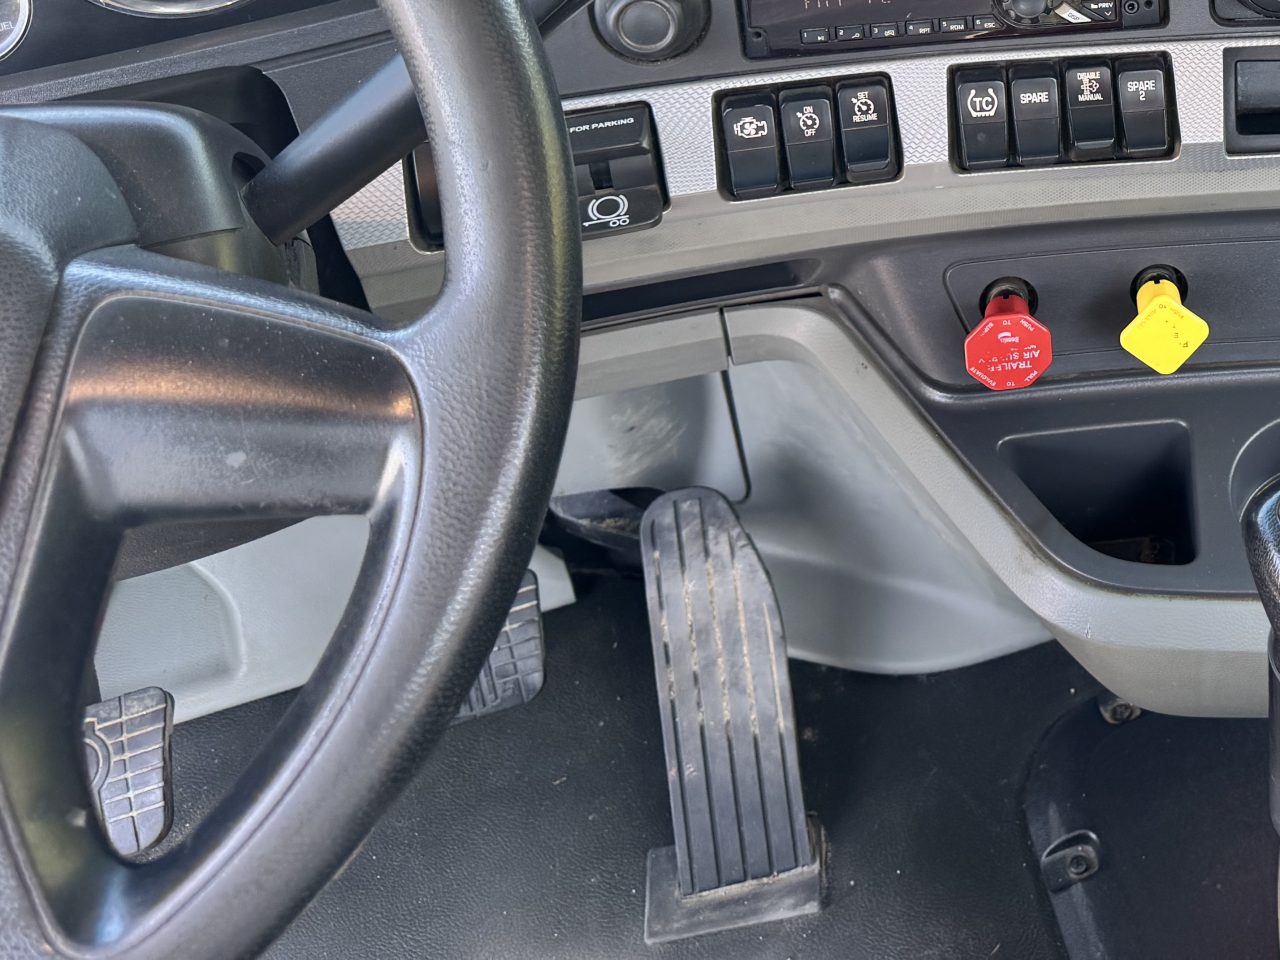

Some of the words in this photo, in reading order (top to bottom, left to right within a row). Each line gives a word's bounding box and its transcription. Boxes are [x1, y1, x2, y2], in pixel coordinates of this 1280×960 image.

[1077, 71, 1101, 80] DISABLE
[1127, 79, 1156, 92] SPARE
[857, 91, 869, 99] SET
[1020, 91, 1049, 105] SPARE
[1078, 93, 1104, 102] MANUAL
[1139, 90, 1146, 101] 2
[973, 96, 993, 112] TC
[803, 105, 813, 114] ON
[852, 112, 878, 123] RESUME
[570, 125, 589, 133] FOR
[592, 118, 634, 129] PARKING
[804, 129, 817, 137] OFF
[1022, 349, 1040, 359] AIR
